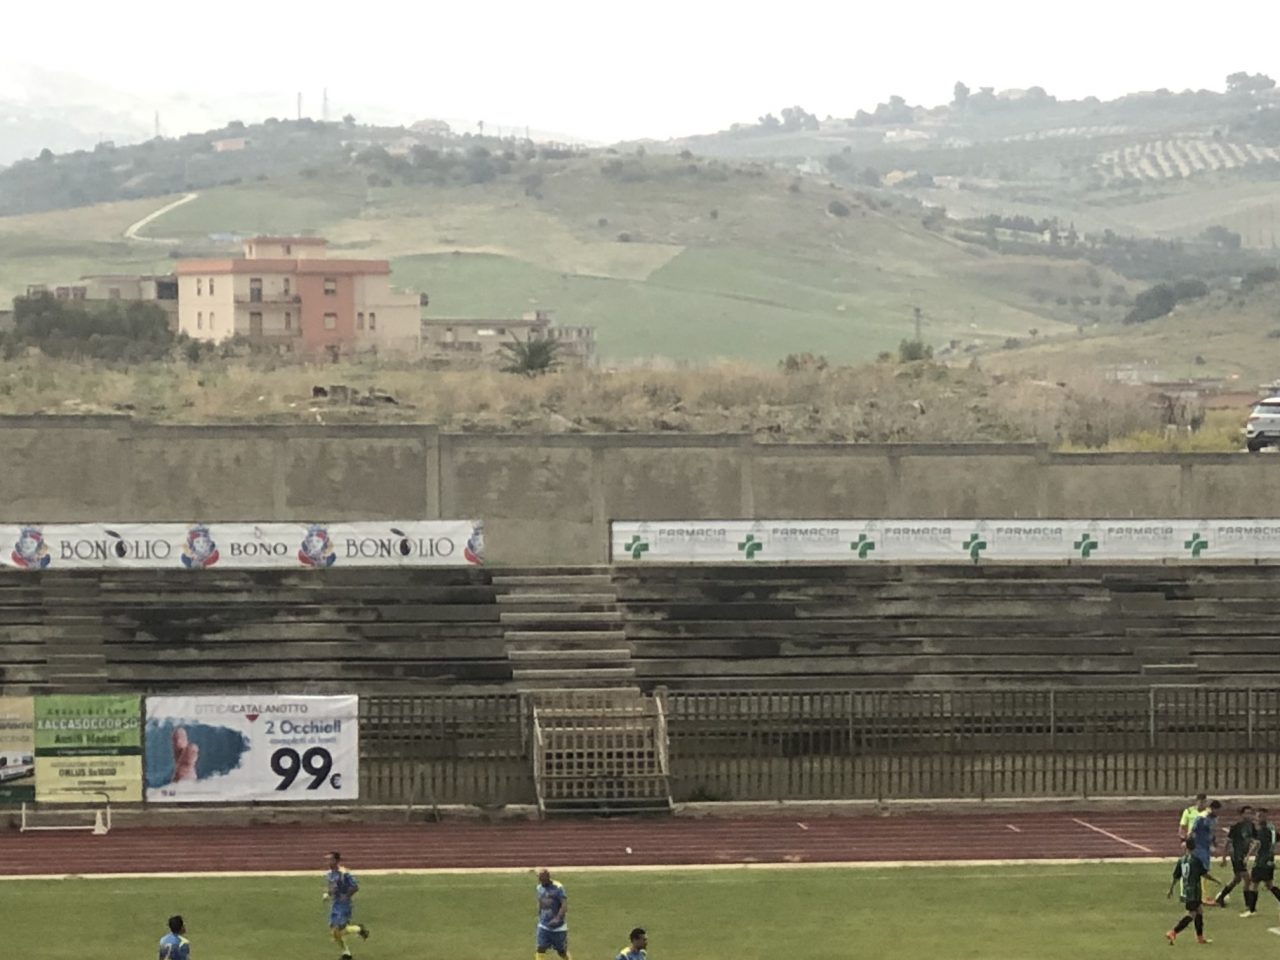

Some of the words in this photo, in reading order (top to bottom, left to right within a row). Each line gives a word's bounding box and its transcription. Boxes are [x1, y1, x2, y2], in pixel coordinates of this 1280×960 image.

[658, 528, 727, 537] FARMACIA
[772, 527, 840, 536] FARMACIA
[884, 527, 952, 536] FARMACIA
[997, 527, 1063, 536] FARMACIA
[1107, 527, 1173, 536] FARMACIA
[230, 541, 288, 557] BONO
[264, 720, 275, 735] 2
[280, 720, 341, 735] Occhiali
